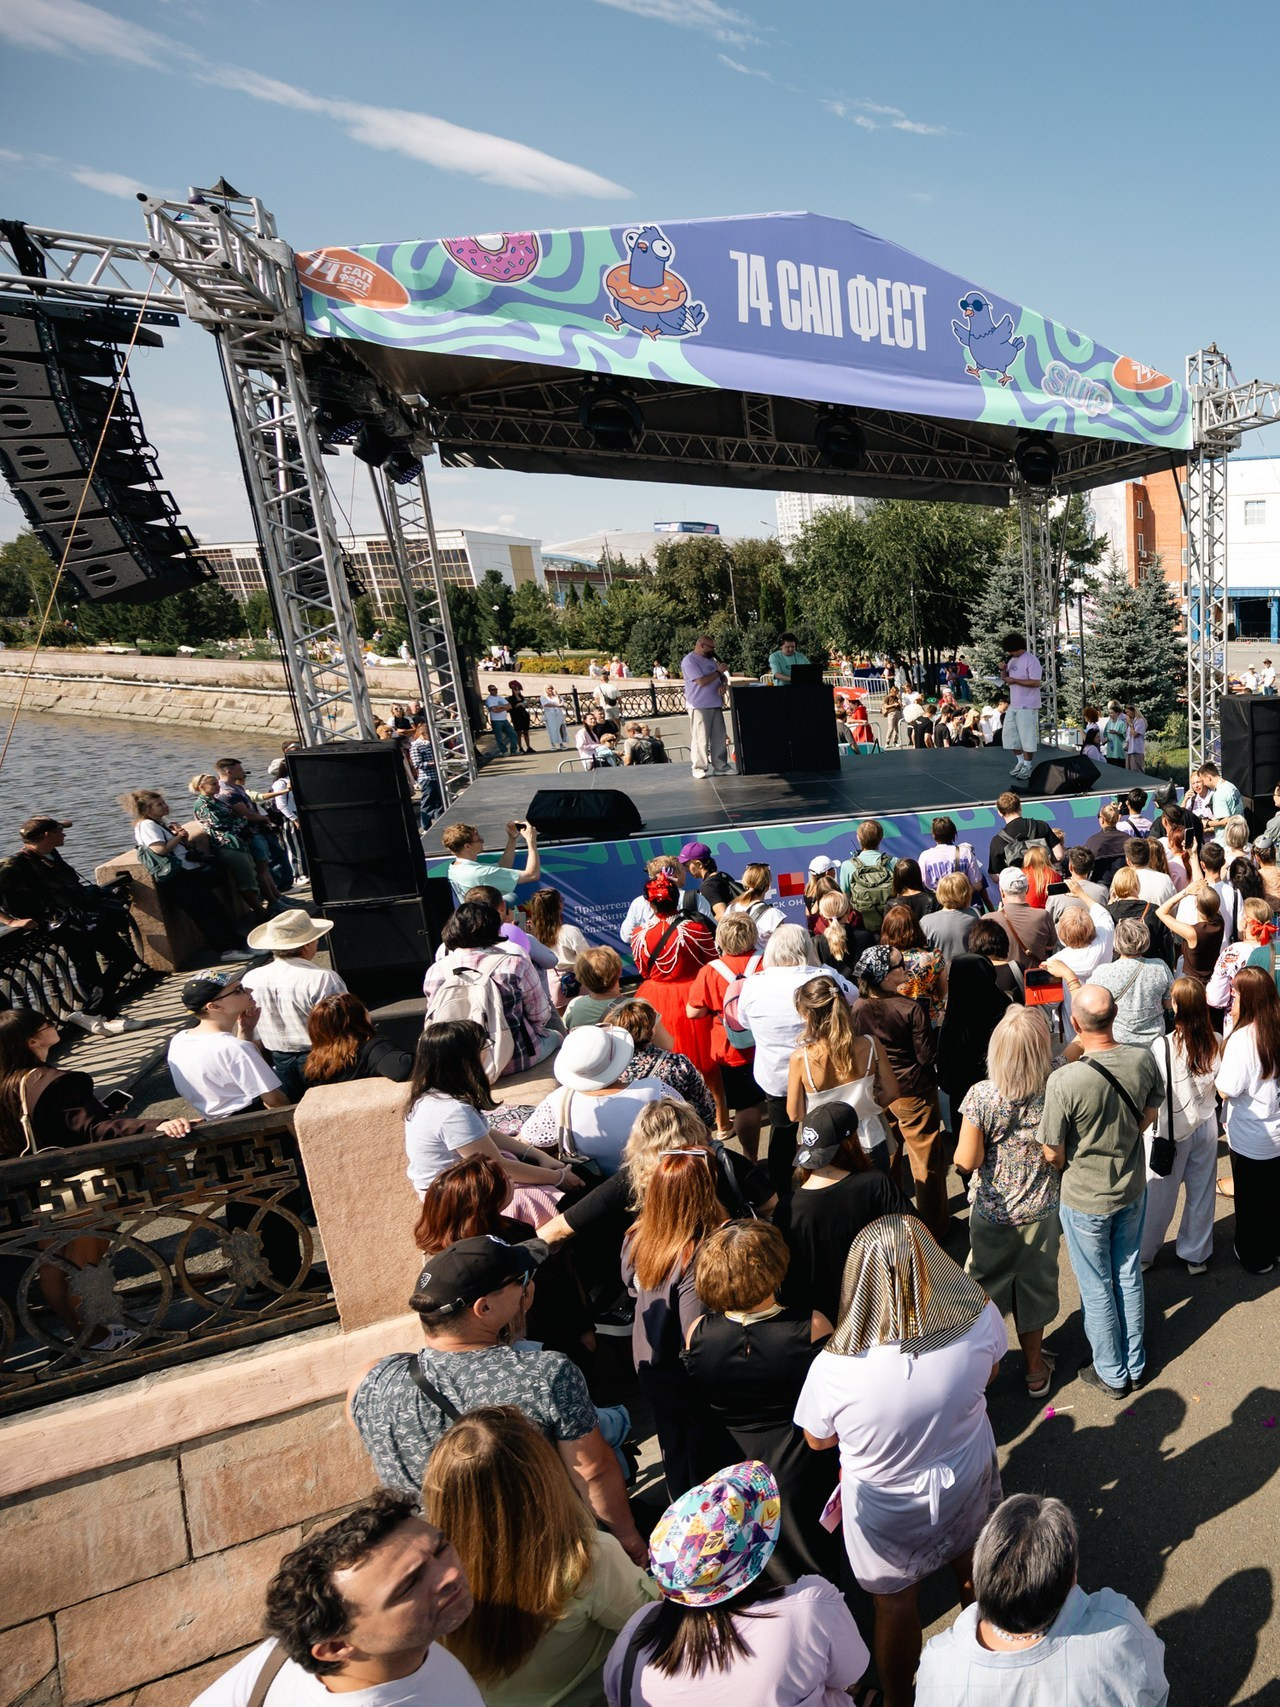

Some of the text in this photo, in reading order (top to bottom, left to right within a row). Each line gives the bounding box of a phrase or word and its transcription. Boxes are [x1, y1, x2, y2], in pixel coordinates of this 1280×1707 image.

[338, 273, 370, 292] ФЕСТ
[341, 265, 374, 284] САП
[729, 250, 927, 351] 74 САП ФЕСТ
